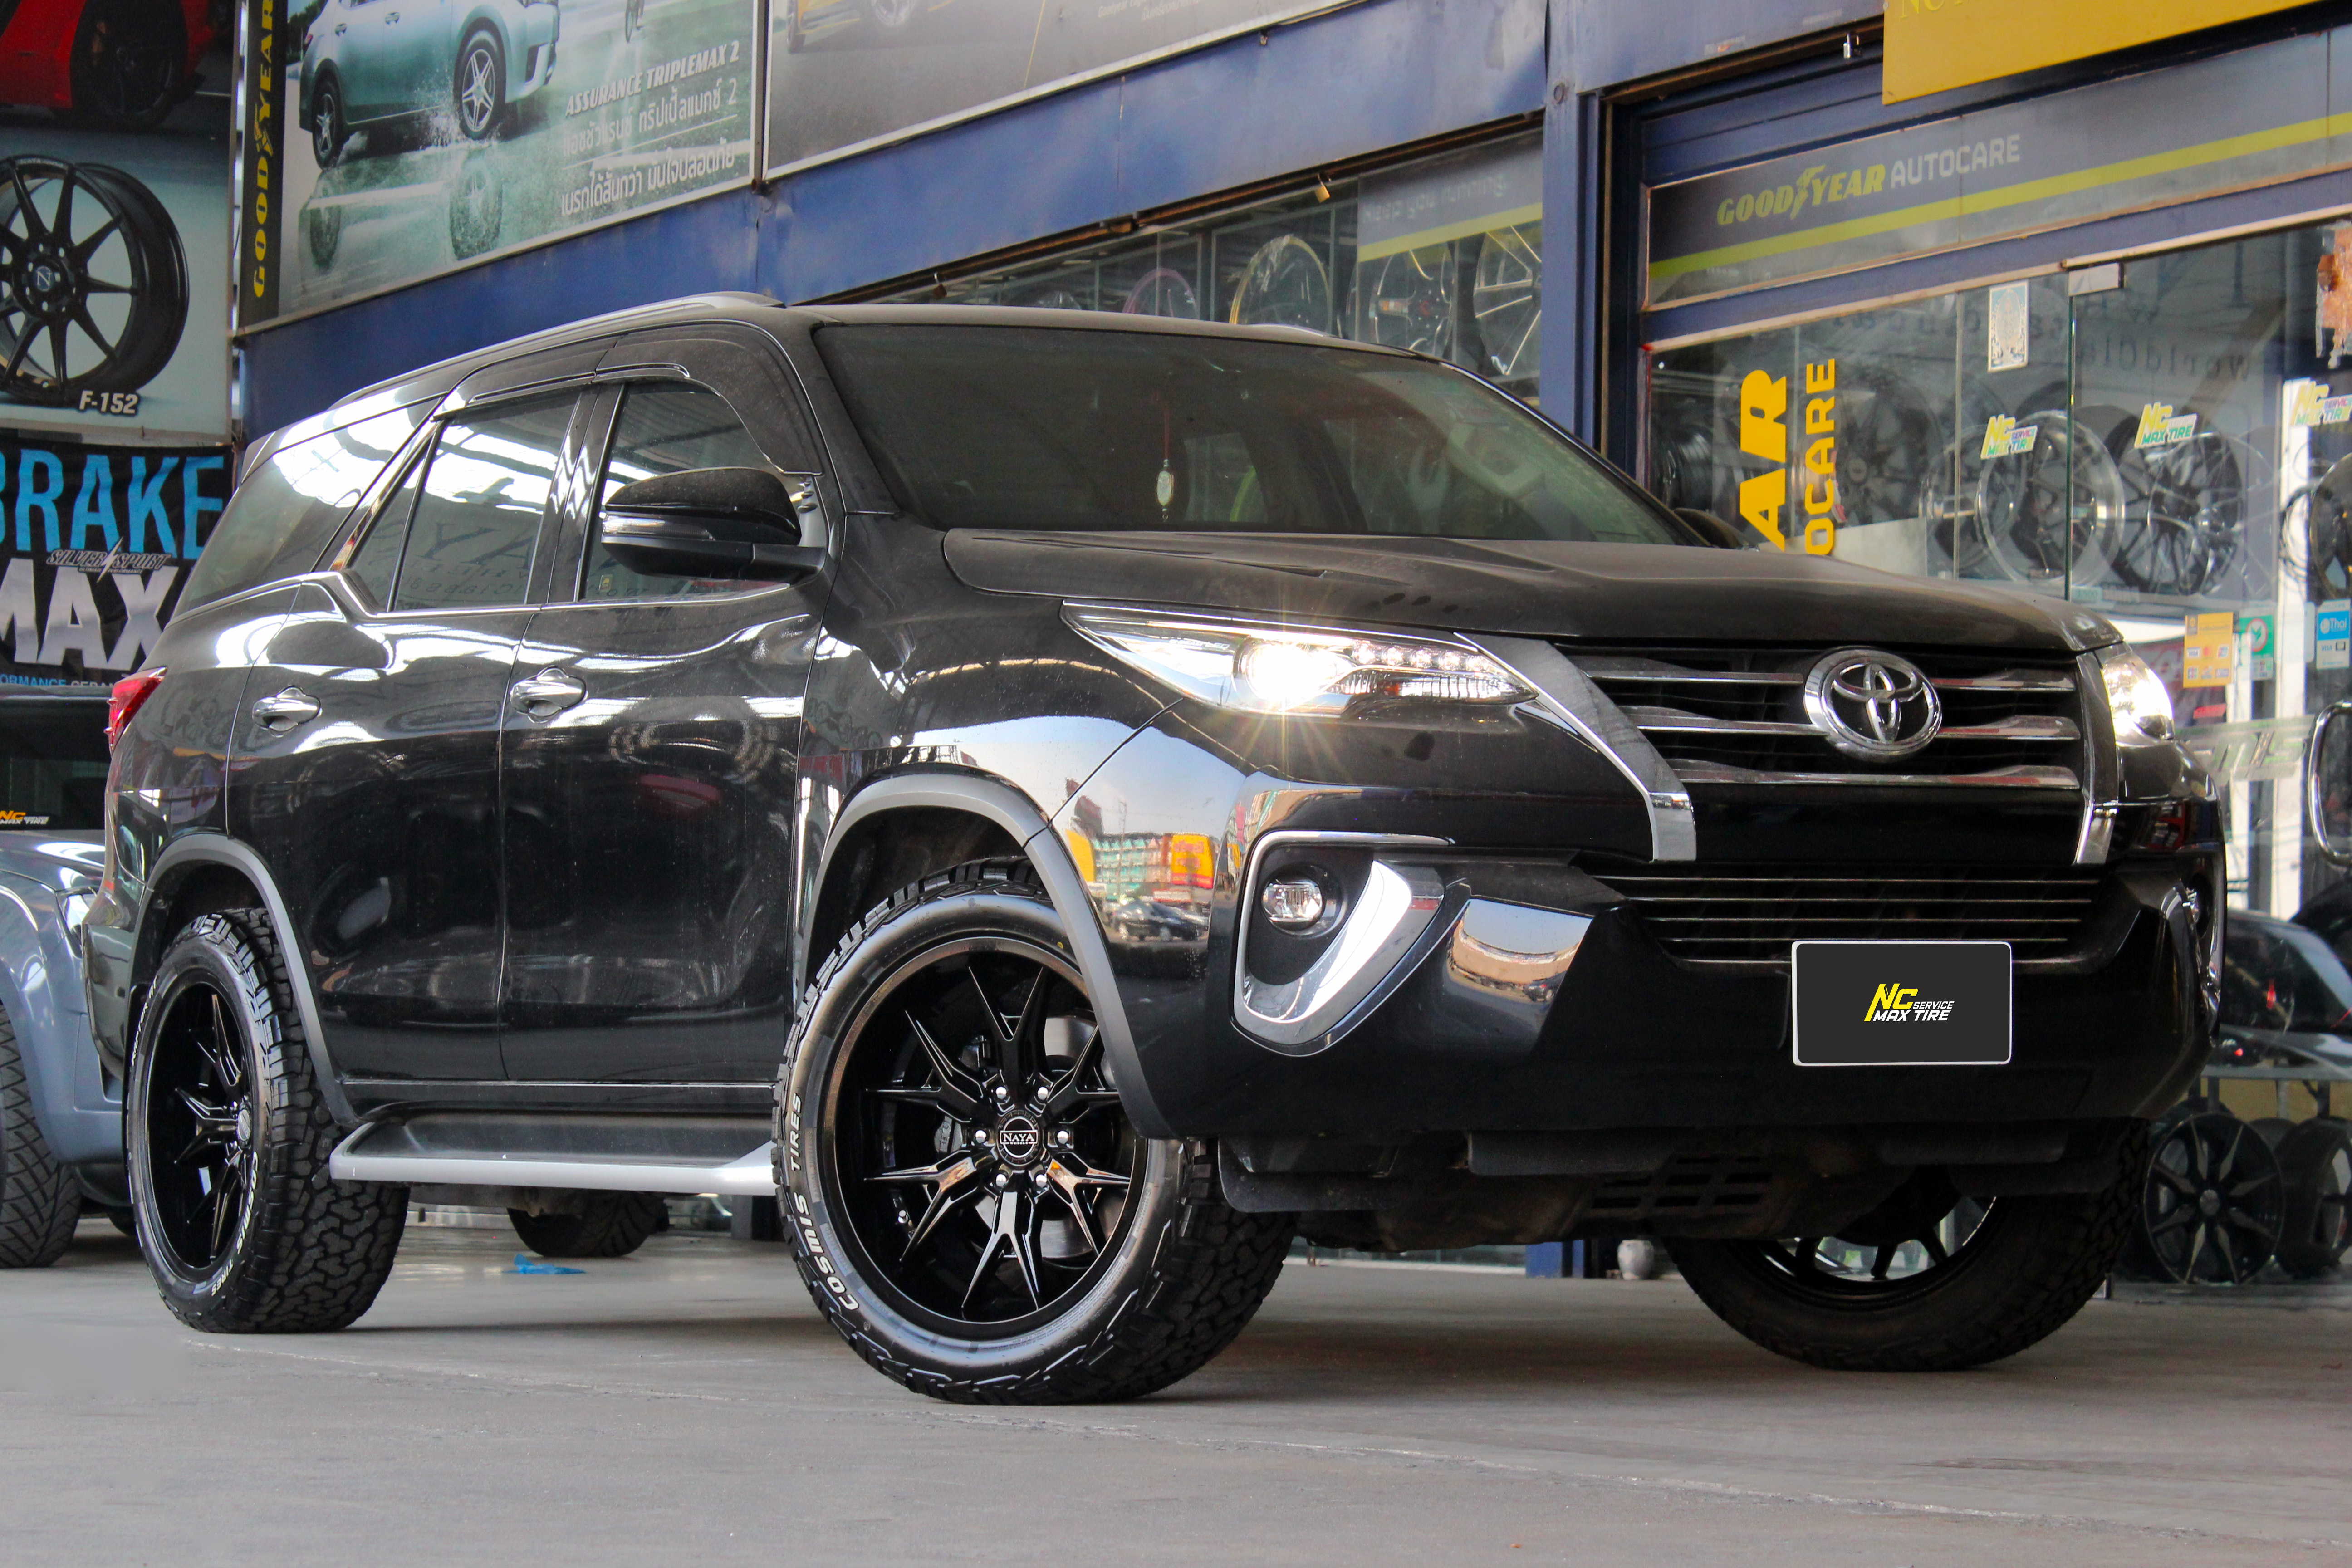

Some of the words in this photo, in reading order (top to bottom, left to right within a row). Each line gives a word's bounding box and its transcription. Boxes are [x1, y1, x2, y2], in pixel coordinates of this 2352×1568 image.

[565, 72, 643, 118] ASSURANCE
[646, 44, 727, 90] TRIPLEMAX
[730, 40, 740, 63] 2
[728, 78, 737, 105] 2
[254, 0, 274, 297] GOODYEAR
[561, 164, 642, 216] เบรกได้สั้นกว่า
[647, 137, 735, 191] มั่นใจปลอดภัย
[1716, 164, 1886, 226] GOODYEAR
[1891, 133, 2021, 188] AUTOCARE
[79, 390, 140, 415] F-152
[2136, 402, 2171, 445] NC
[2290, 382, 2329, 426] NC
[2323, 407, 2351, 421] TIRE
[1804, 358, 1835, 556] OCARE
[1982, 415, 2015, 458] NC
[2011, 437, 2033, 451] TIRE
[2141, 431, 2166, 445] MAX
[2168, 426, 2193, 440] TIRE
[0, 449, 224, 560] RAKE
[46, 549, 108, 567] SILVER
[112, 552, 172, 571] SPORT
[789, 1092, 803, 1172] TIRES
[1003, 1133, 1035, 1142] NAYA
[236, 1150, 258, 1255] COSMIS
[794, 1191, 860, 1312] COSMIS
[211, 1259, 234, 1297] TIRES
